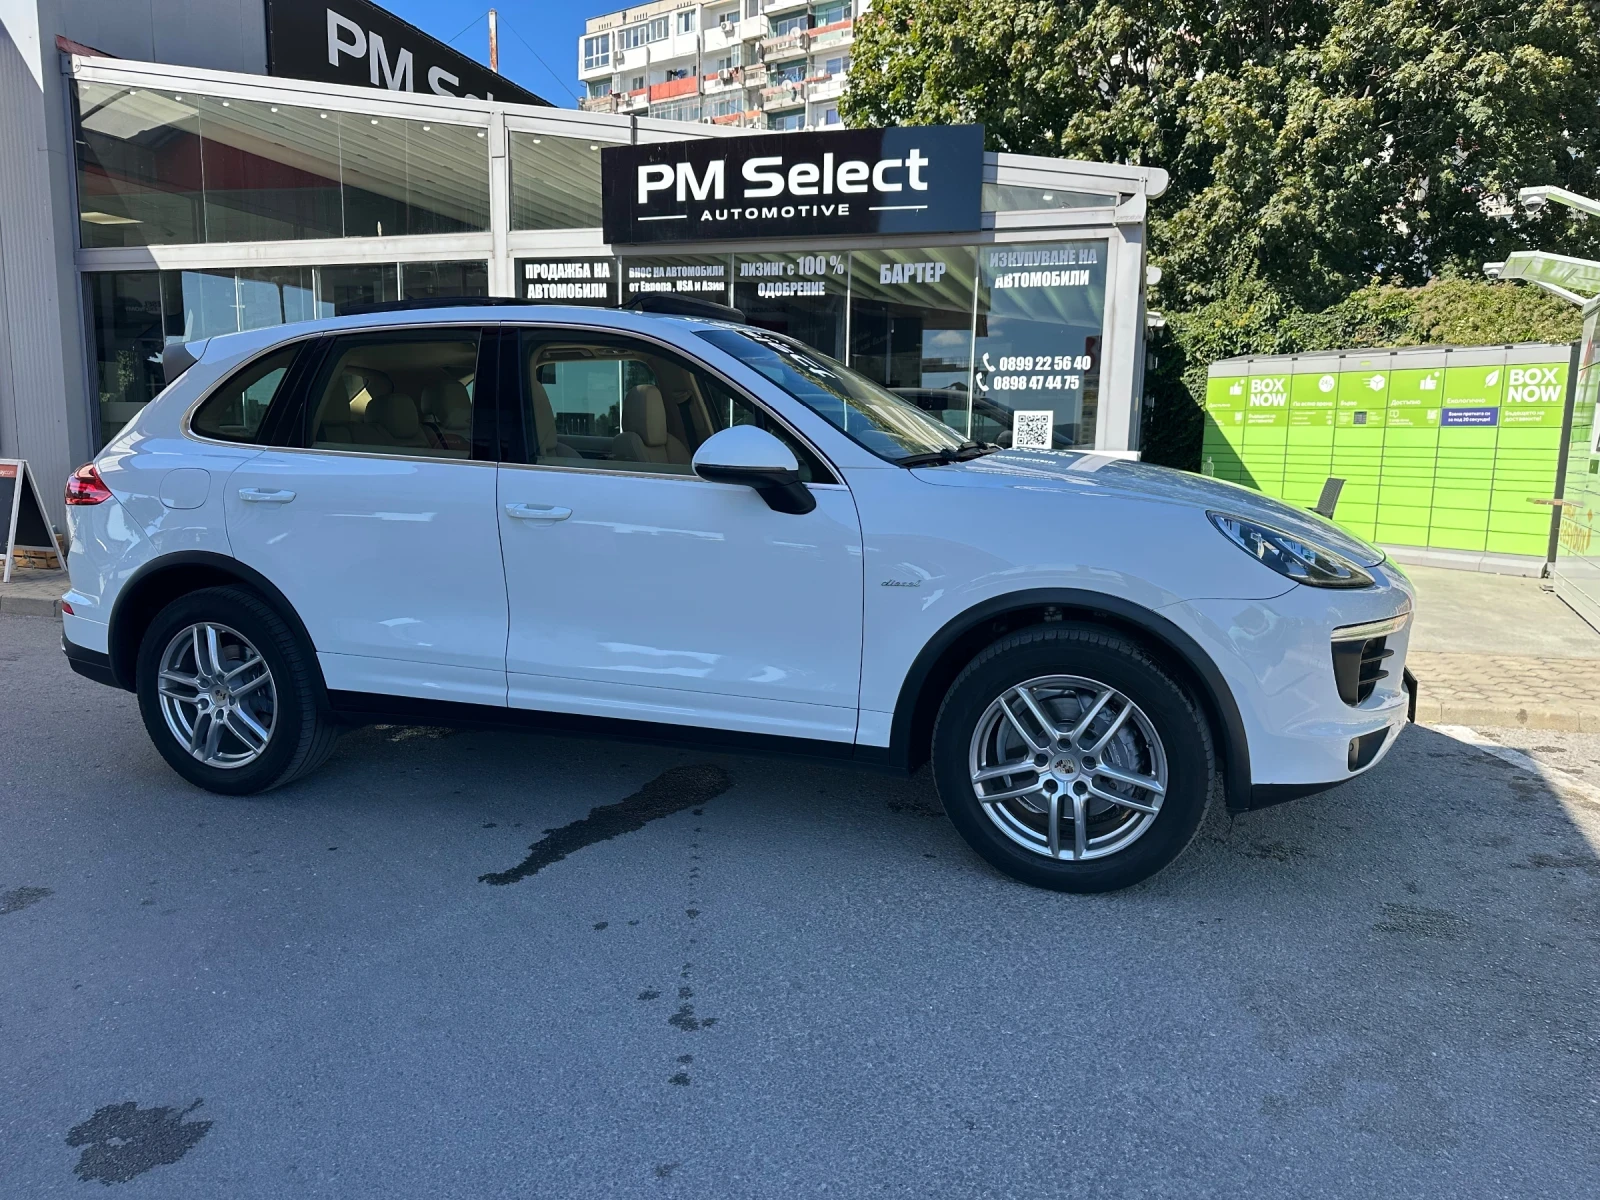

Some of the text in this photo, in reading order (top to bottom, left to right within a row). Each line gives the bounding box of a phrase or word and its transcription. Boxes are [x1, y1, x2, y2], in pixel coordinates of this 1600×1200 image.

[326, 8, 414, 92] PM
[637, 148, 929, 204] PM Select
[700, 204, 850, 221] AUTOMOTIVE
[740, 255, 845, 277] ЛИЗИНГ с 100 %
[989, 248, 1097, 267] ИЗКУПУВАНЕ НА
[525, 262, 610, 281] ПРОДАЖБА НА
[629, 265, 724, 278] ВНОС НА АВТОМОБИЛИ
[879, 262, 946, 285] БАРТЕР
[994, 270, 1090, 289] АВТОМОБИЛИ
[527, 283, 607, 299] АВТОМОБИЛИ
[629, 282, 639, 292] от
[676, 281, 693, 292] USA
[694, 281, 701, 291] и
[701, 280, 725, 291] Азия
[757, 281, 826, 298] ОДОБРЕНИЕ
[999, 355, 1092, 371] 0899 22 56 40
[993, 375, 1080, 390] 0898 47 44 75
[1509, 367, 1559, 385] BOX
[1250, 378, 1285, 393] BOX
[1506, 385, 1562, 403] NOW
[1249, 393, 1287, 407] NOW
